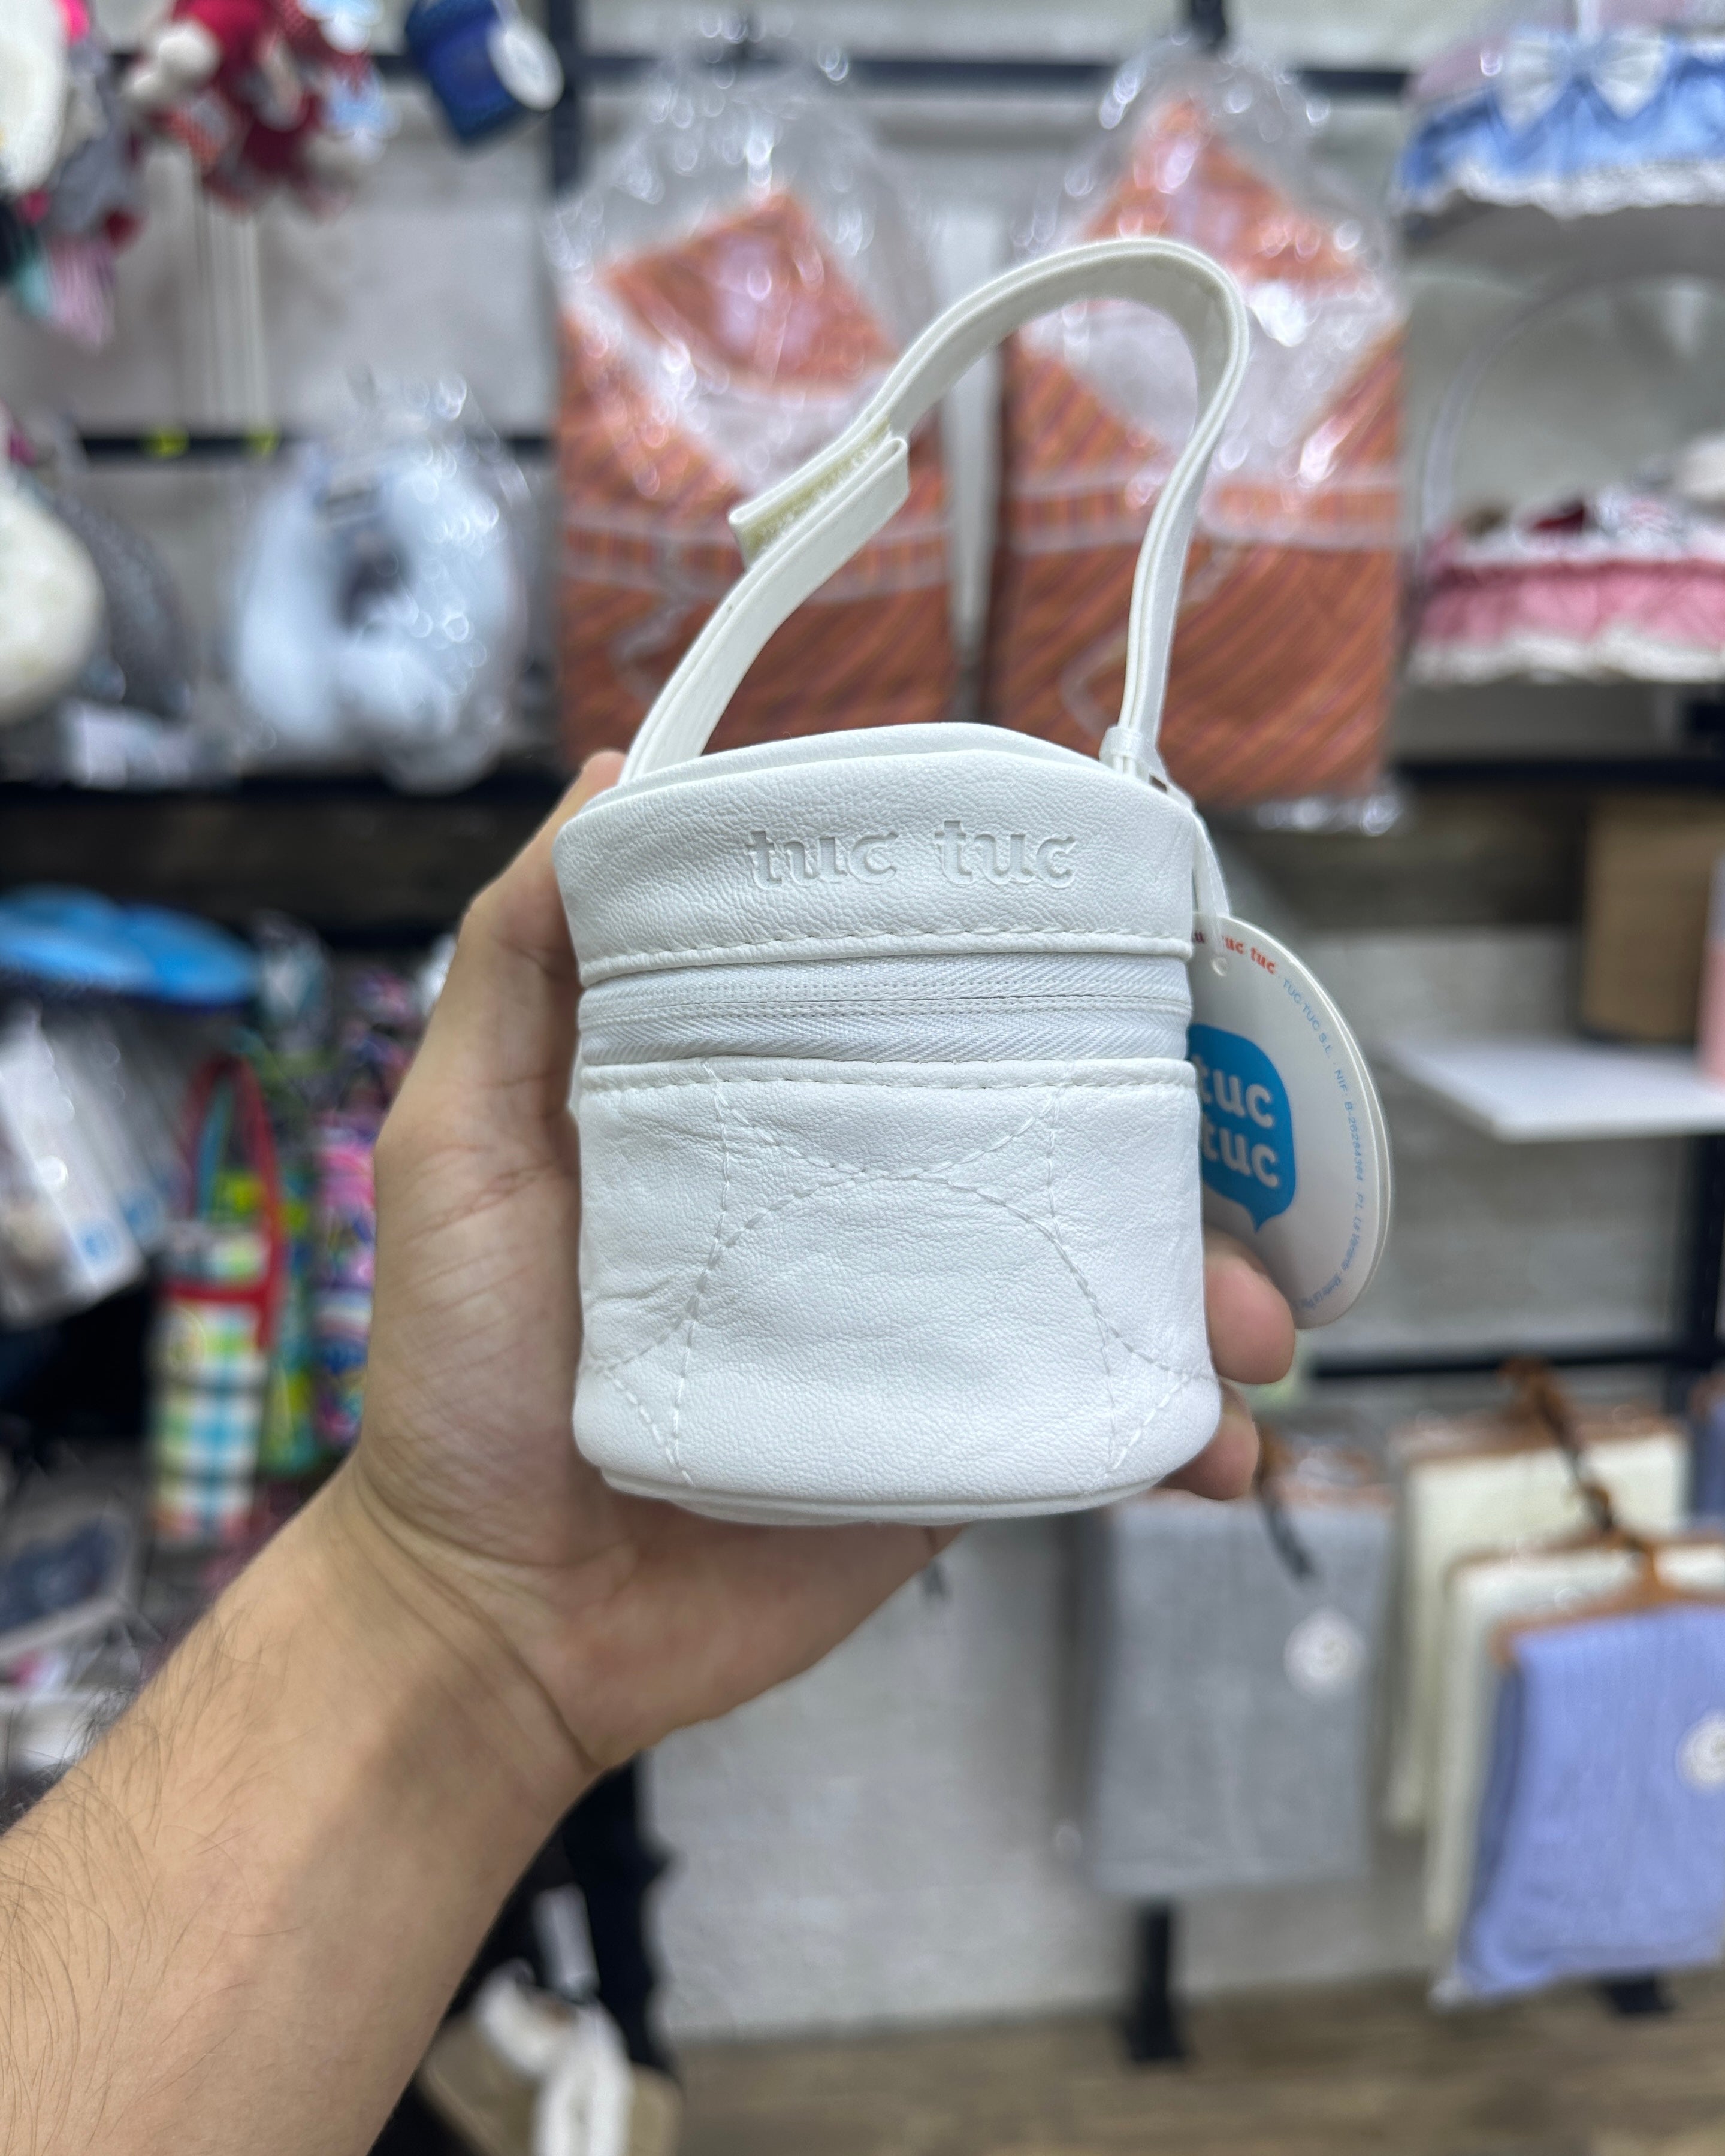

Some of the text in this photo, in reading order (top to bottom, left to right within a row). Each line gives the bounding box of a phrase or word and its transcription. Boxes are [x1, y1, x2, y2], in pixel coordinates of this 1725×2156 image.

[746, 820, 1077, 890] tuc tuc
[1222, 935, 1244, 955] uc
[1250, 947, 1276, 975] tuc
[1283, 978, 1301, 1005] TUC
[1303, 1002, 1320, 1031] TUC
